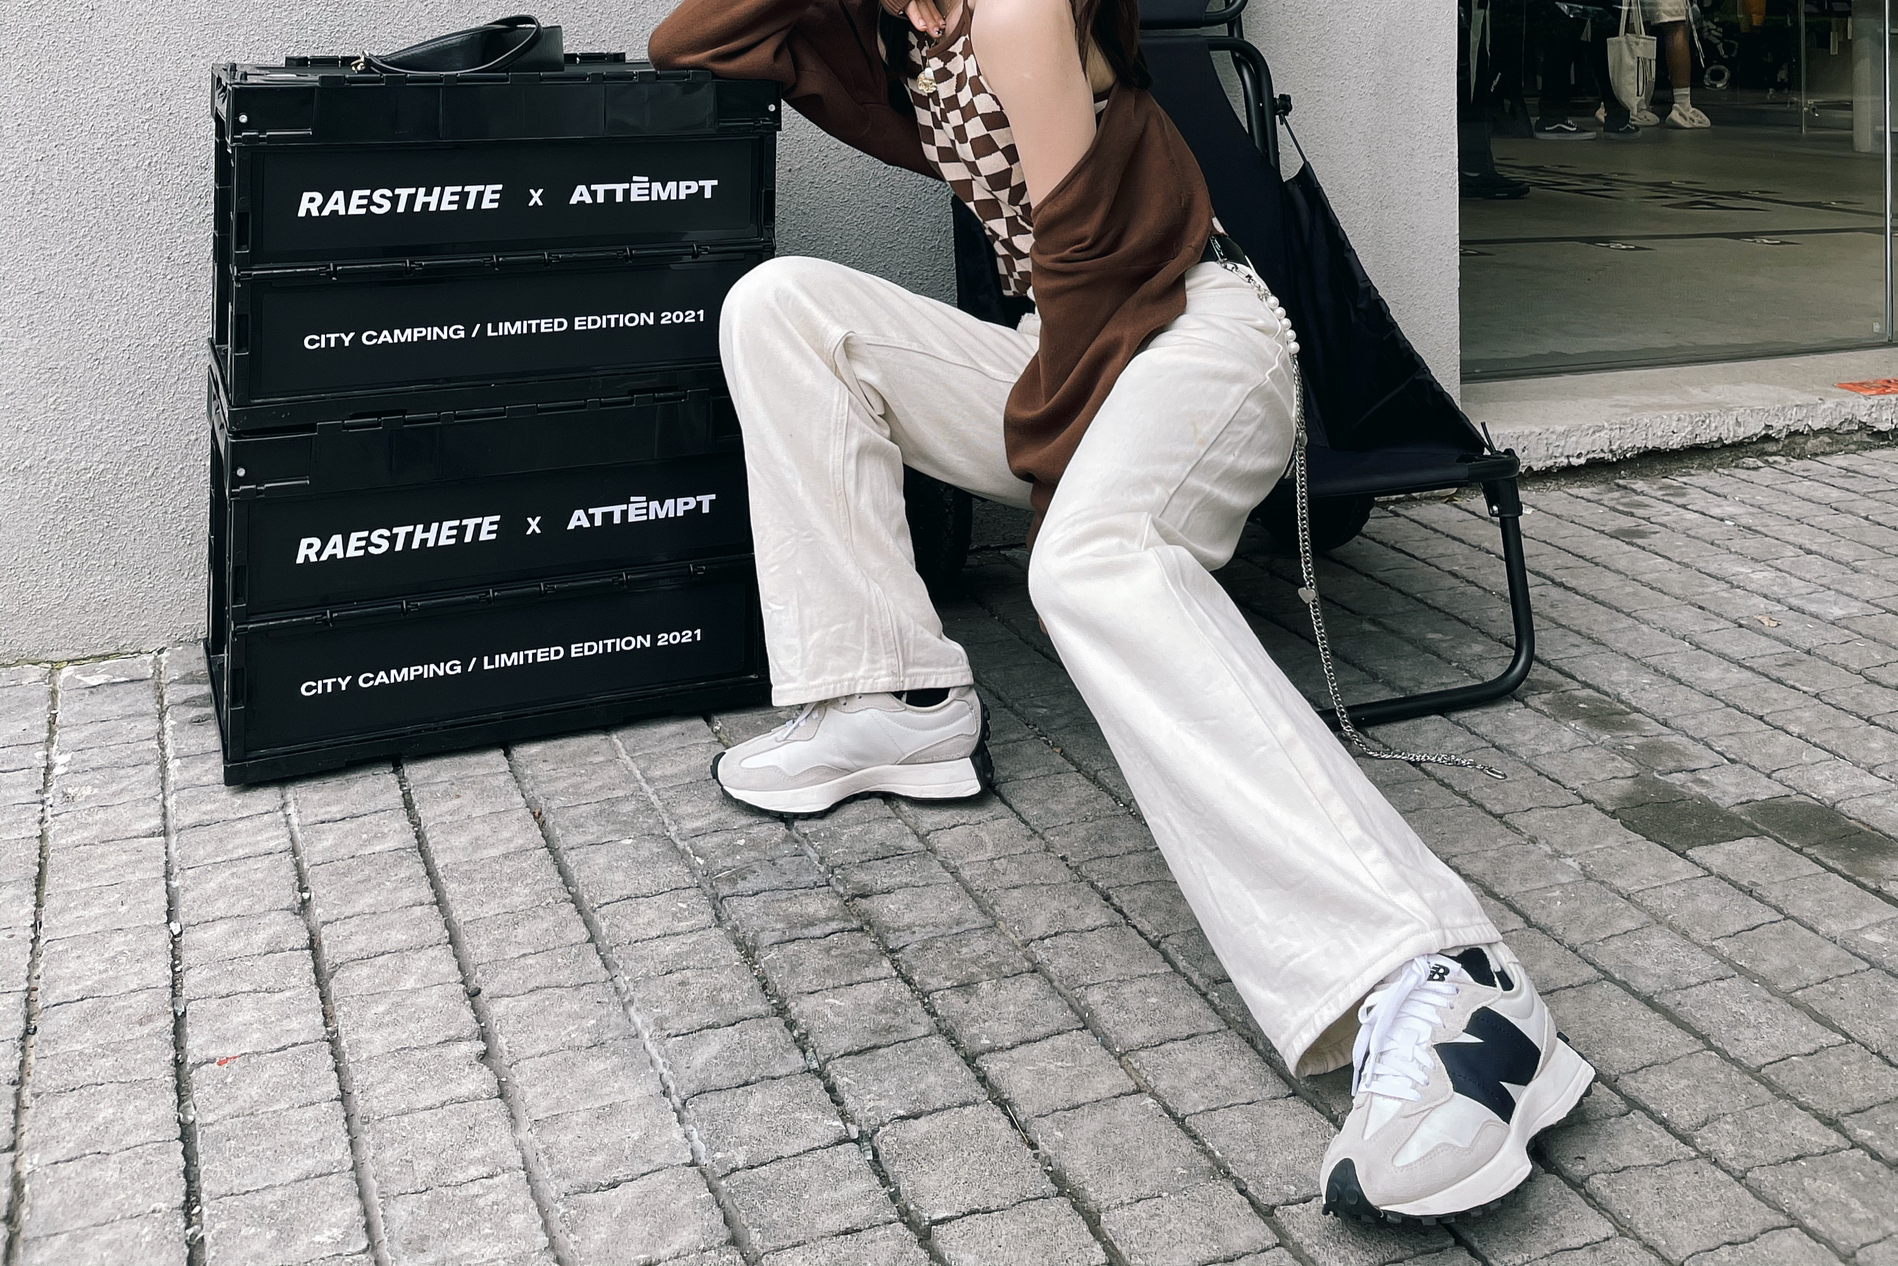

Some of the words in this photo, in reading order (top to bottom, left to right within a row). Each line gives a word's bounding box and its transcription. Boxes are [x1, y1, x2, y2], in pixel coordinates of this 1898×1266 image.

[297, 183, 504, 218] RAESTHETE
[303, 331, 356, 350] CITY
[361, 324, 465, 346] CAMPING
[471, 323, 481, 338] /
[486, 317, 568, 337] LIMITED
[574, 311, 655, 331] EDITION
[660, 309, 705, 325] 2021
[295, 514, 501, 565] RAESTHETE
[300, 675, 353, 697] CITY
[358, 659, 462, 688] CAMPING
[467, 657, 477, 673] /
[483, 645, 565, 670] LIMITED
[570, 634, 651, 658] EDITION
[656, 628, 702, 647] 2021
